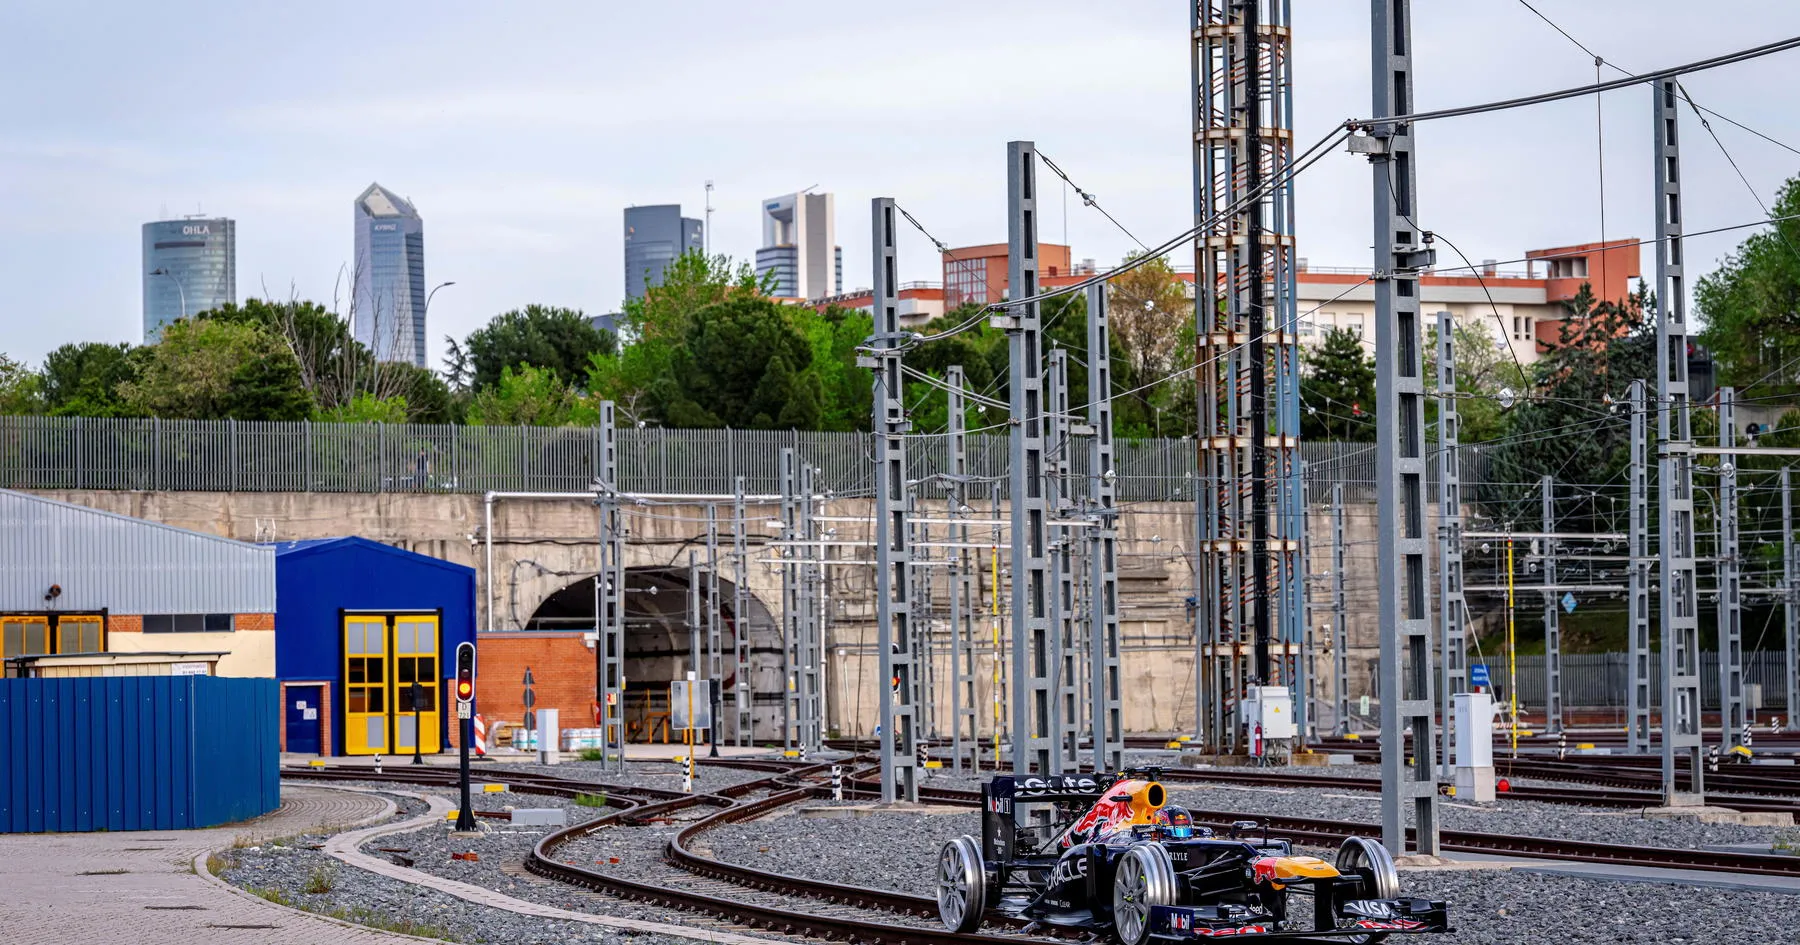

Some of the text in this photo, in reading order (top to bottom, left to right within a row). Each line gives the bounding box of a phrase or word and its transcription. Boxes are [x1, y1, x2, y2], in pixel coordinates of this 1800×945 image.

[183, 225, 210, 235] OHLA
[987, 796, 1003, 813] Mobil
[1168, 852, 1188, 861] RLYLE
[1344, 900, 1391, 916] VISA
[1171, 912, 1190, 930] Mobil
